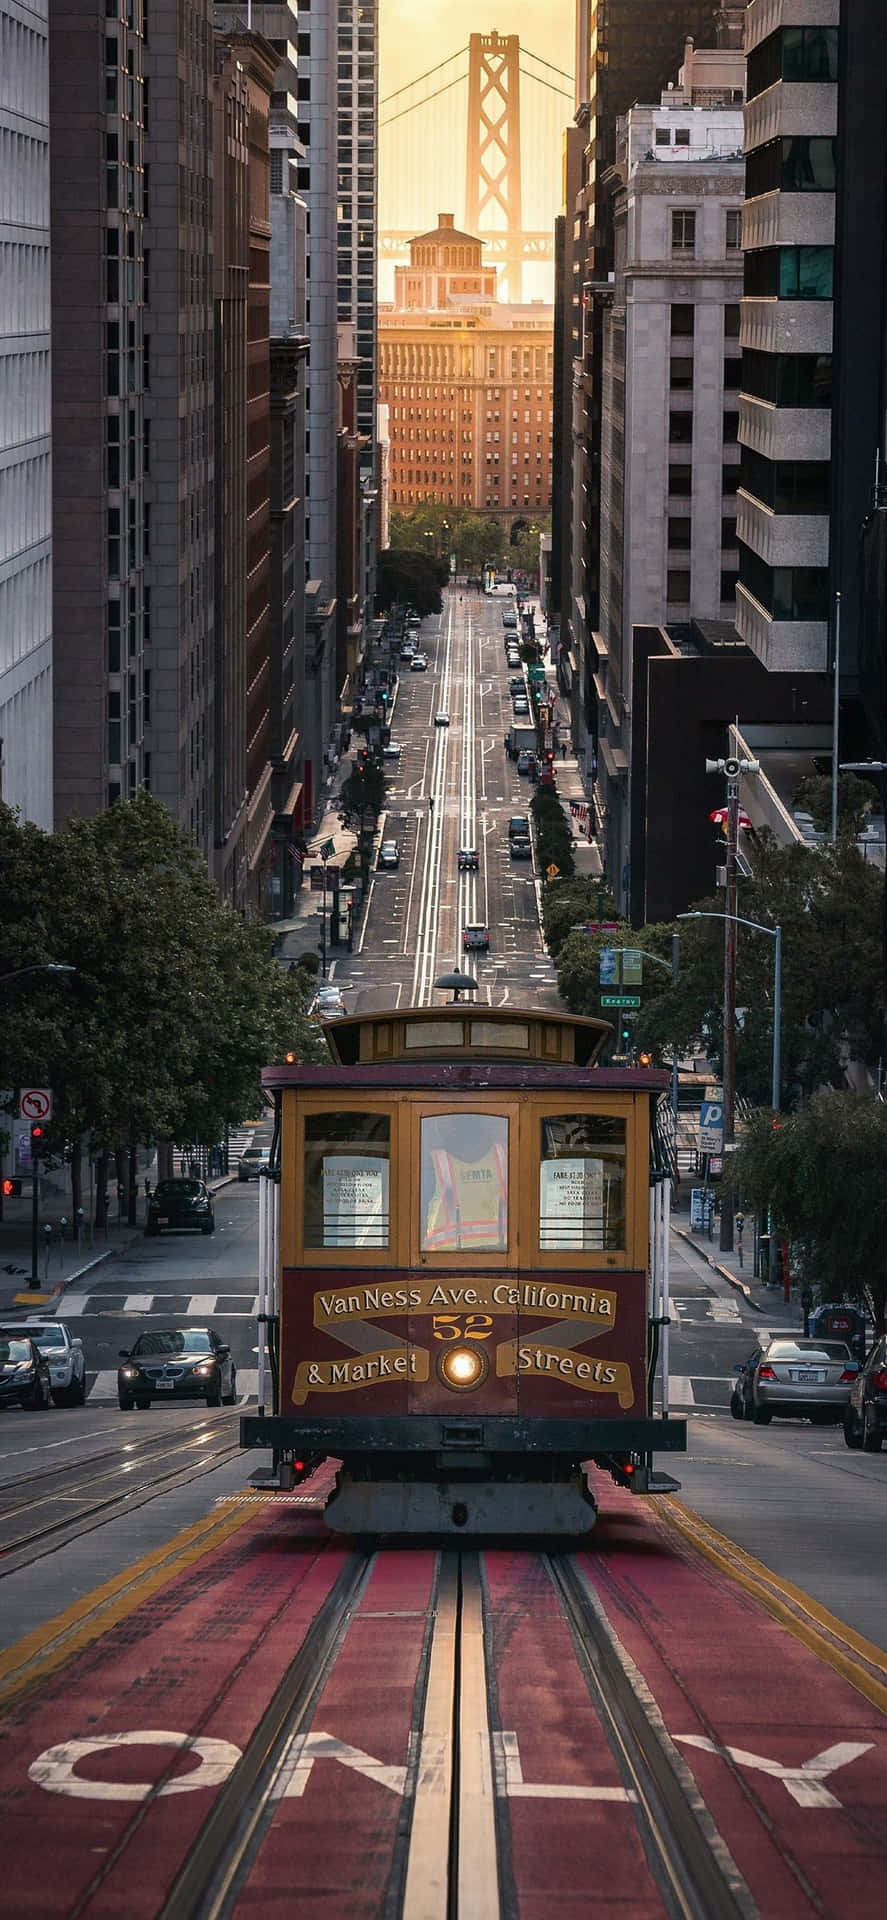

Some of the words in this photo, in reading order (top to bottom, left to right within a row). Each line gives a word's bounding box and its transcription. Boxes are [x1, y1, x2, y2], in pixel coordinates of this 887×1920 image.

[320, 1295, 361, 1317] Van
[363, 1288, 421, 1310] Ness
[493, 1285, 612, 1316] California
[433, 1314, 493, 1341] 52
[308, 1363, 326, 1384] &
[330, 1353, 417, 1384] Market
[518, 1348, 617, 1384] Streets
[28, 1730, 876, 1808] ONLY
